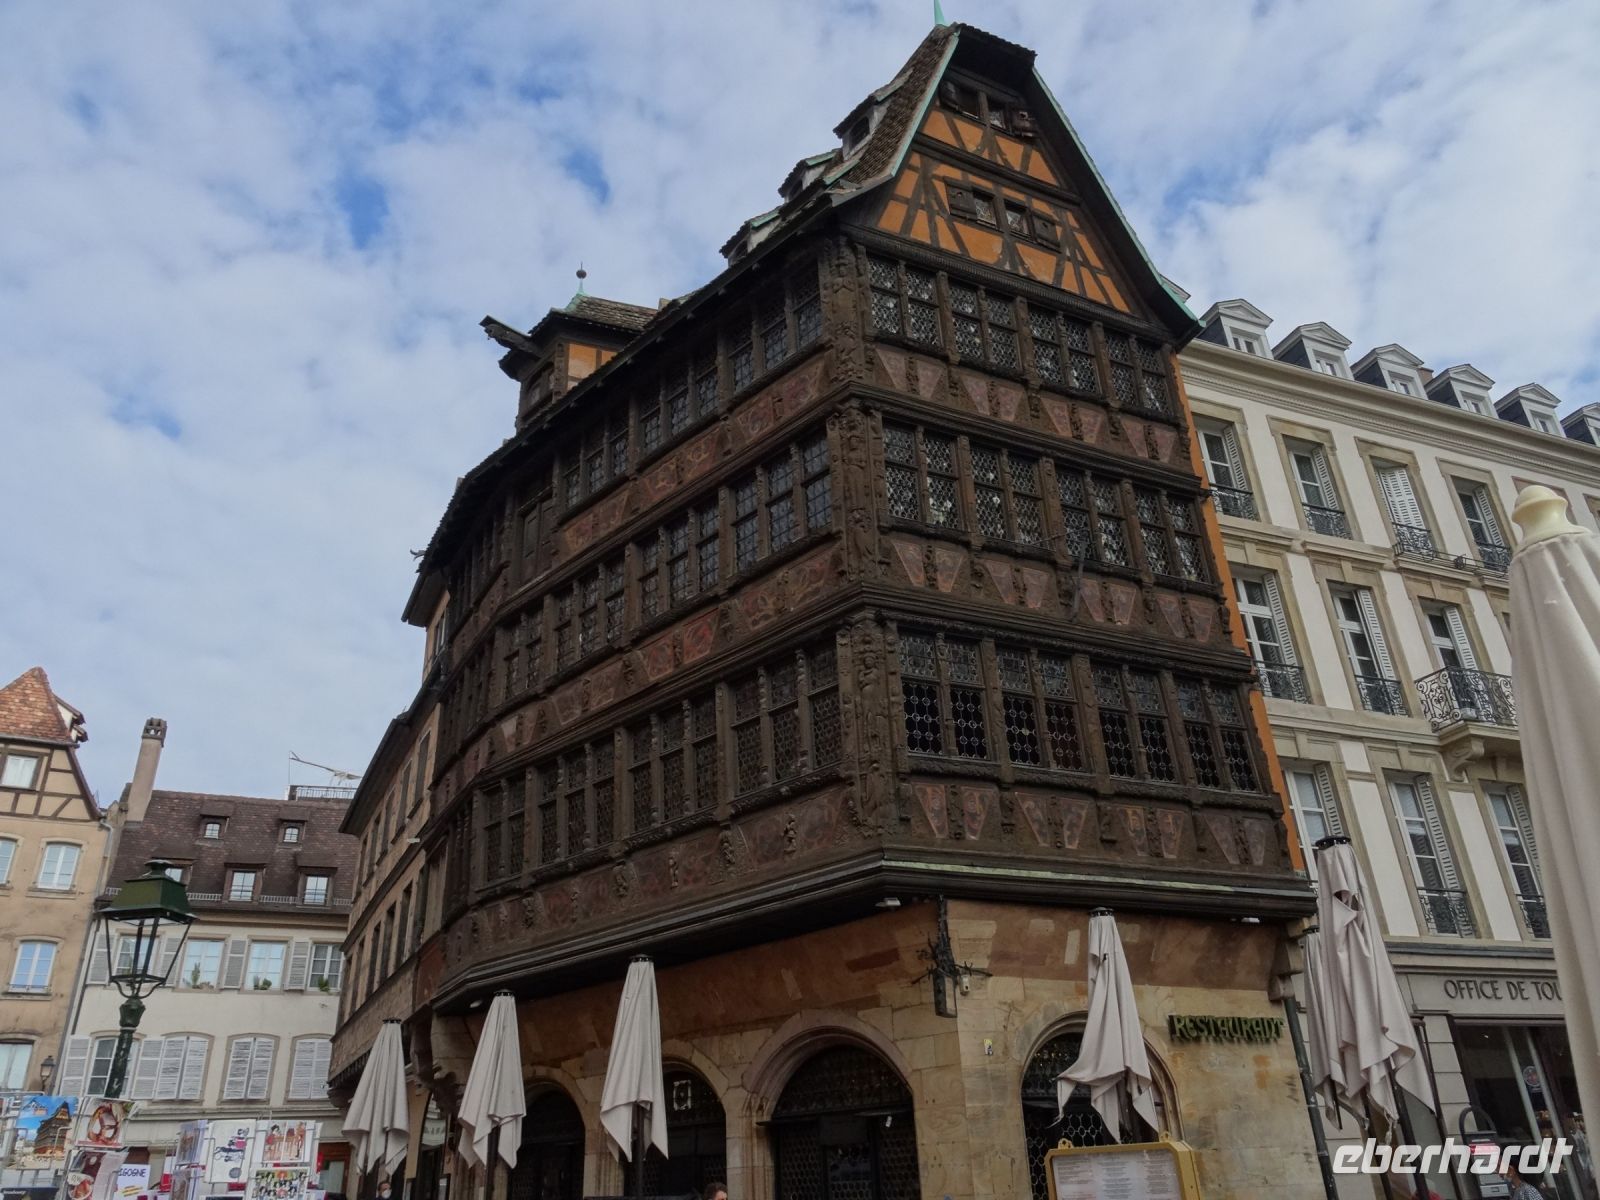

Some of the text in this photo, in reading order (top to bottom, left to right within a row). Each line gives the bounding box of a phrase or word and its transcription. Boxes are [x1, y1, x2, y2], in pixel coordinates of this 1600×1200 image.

[1444, 979, 1503, 1000] OFFICE
[1506, 981, 1530, 1001] DE
[1168, 1014, 1284, 1042] RESTAURANT
